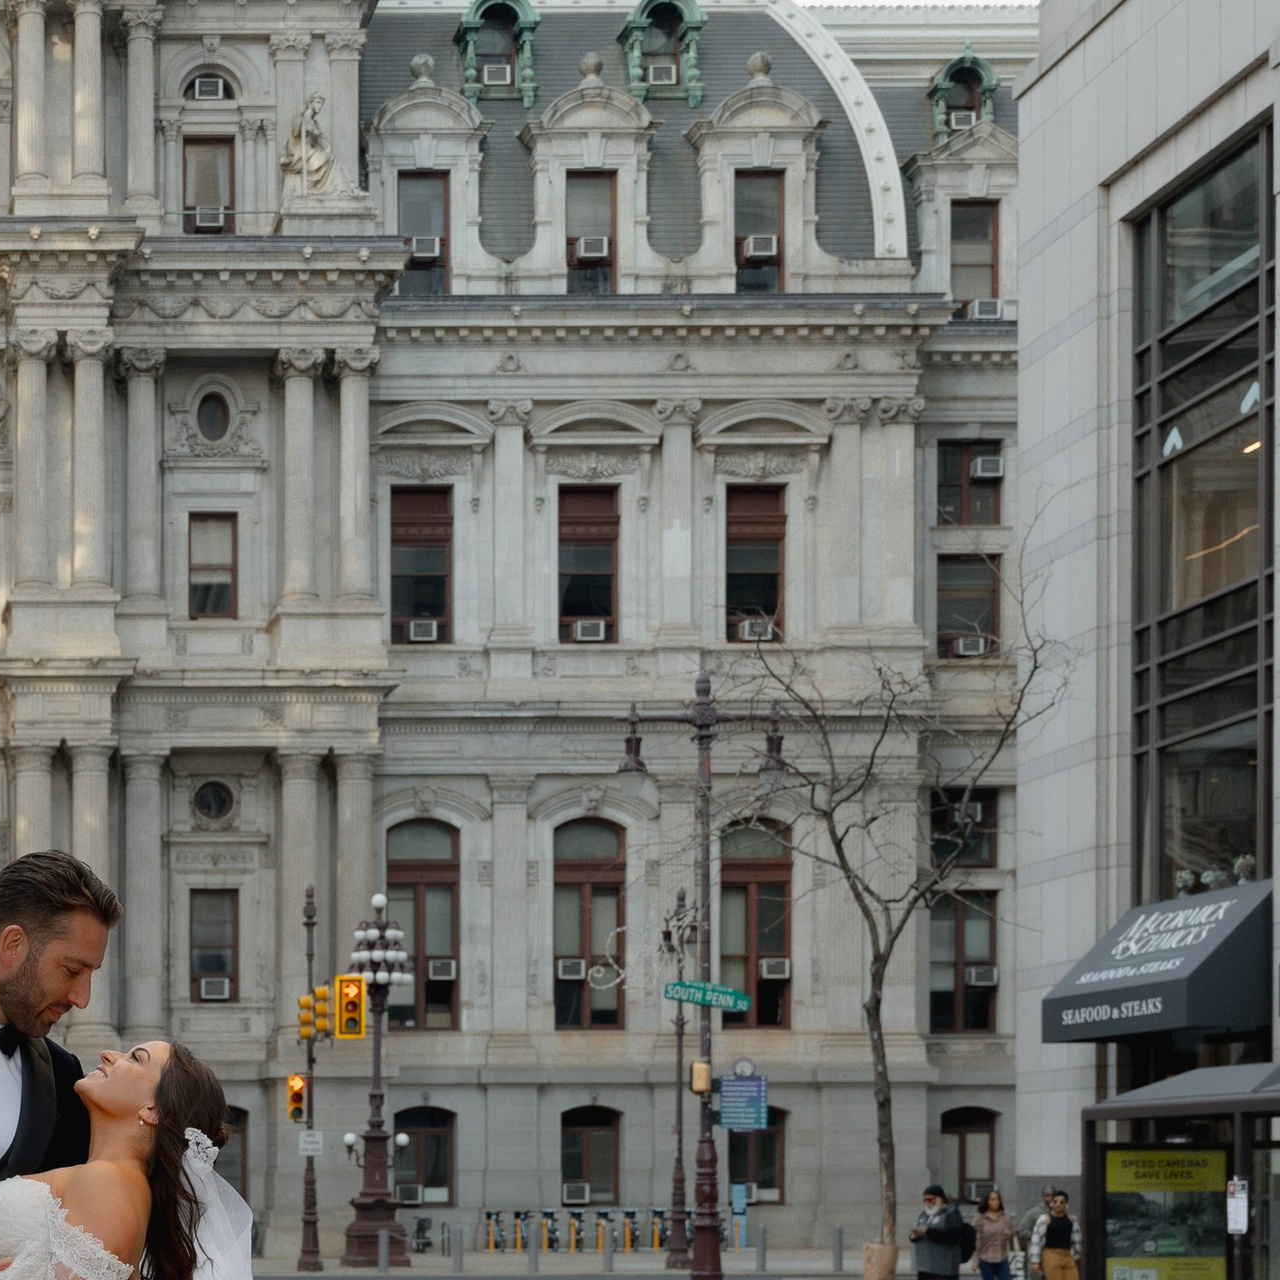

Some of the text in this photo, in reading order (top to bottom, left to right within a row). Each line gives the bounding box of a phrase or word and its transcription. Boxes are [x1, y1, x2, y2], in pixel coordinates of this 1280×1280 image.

[1136, 956, 1185, 976] STEAKS
[666, 984, 703, 1004] SOUTH
[705, 991, 735, 1008] PENN
[1061, 996, 1163, 1026] SEAFOOD & STEAKS
[1121, 1159, 1209, 1169] SPEED CAMERAS
[1134, 1170, 1161, 1180] SAVE
